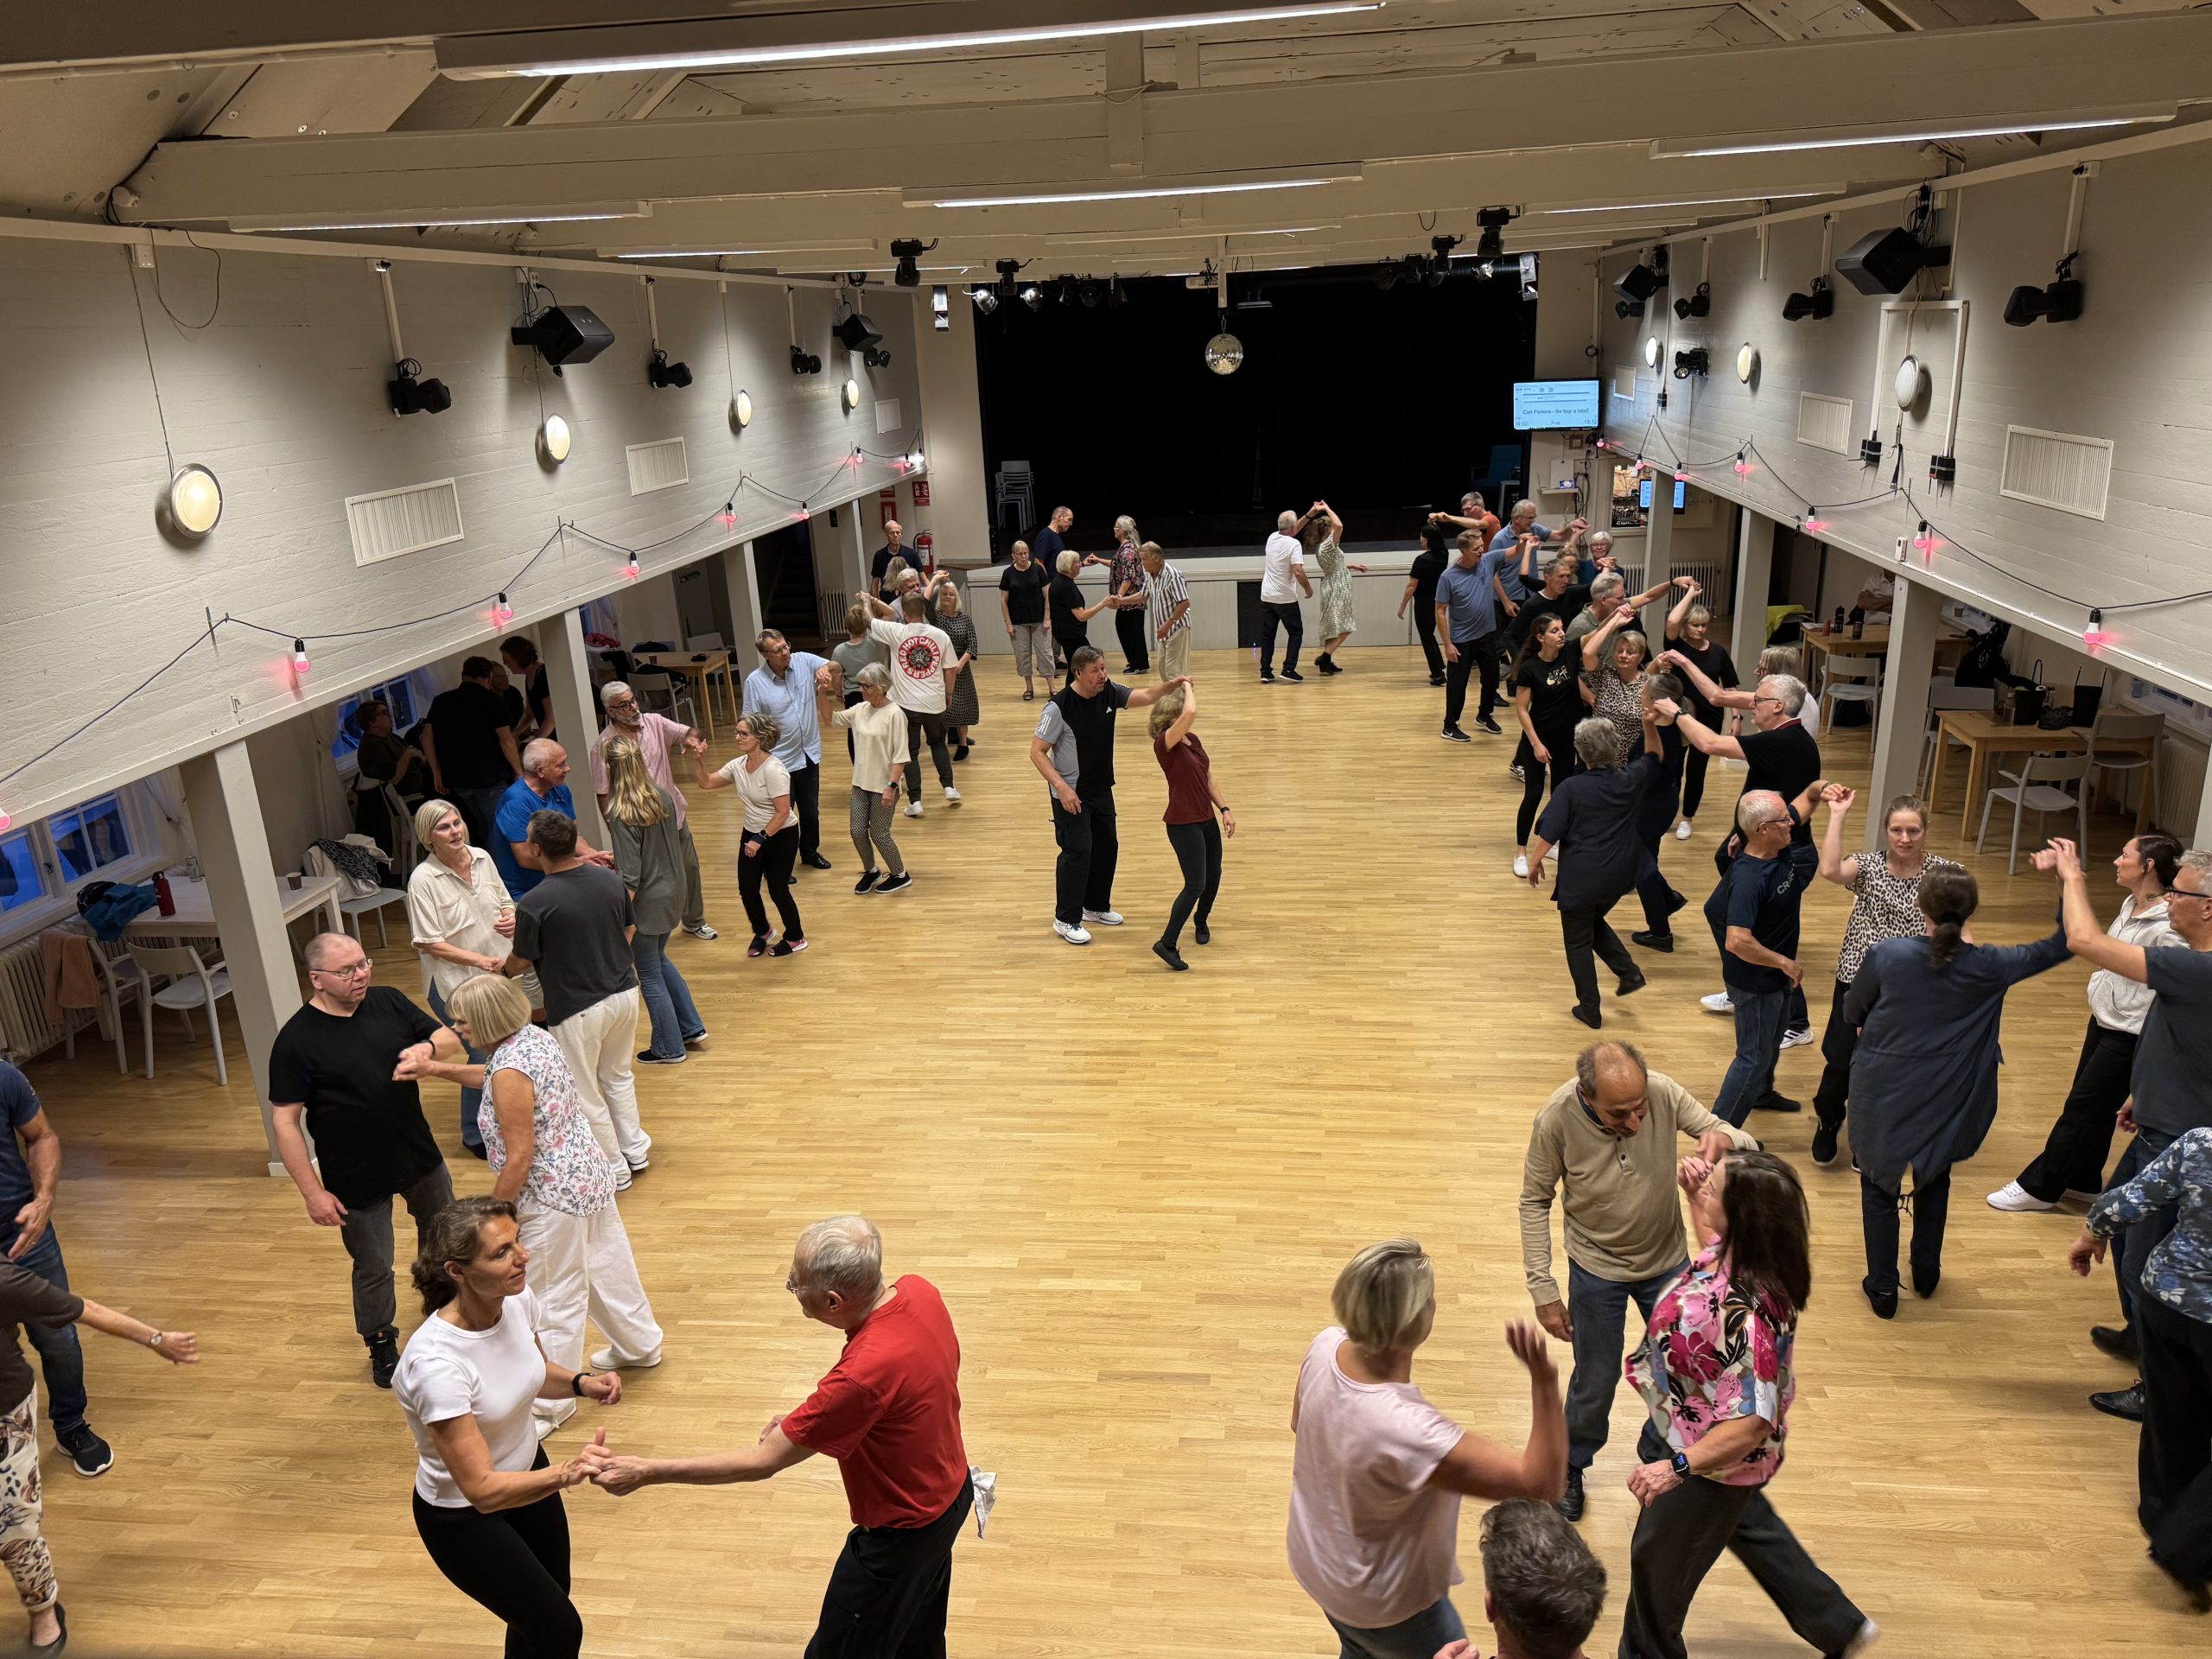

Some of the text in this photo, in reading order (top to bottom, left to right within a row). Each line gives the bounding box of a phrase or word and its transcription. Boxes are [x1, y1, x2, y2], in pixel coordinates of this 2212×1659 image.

[899, 637, 940, 678] RED HOT CHILI PEPPERS
